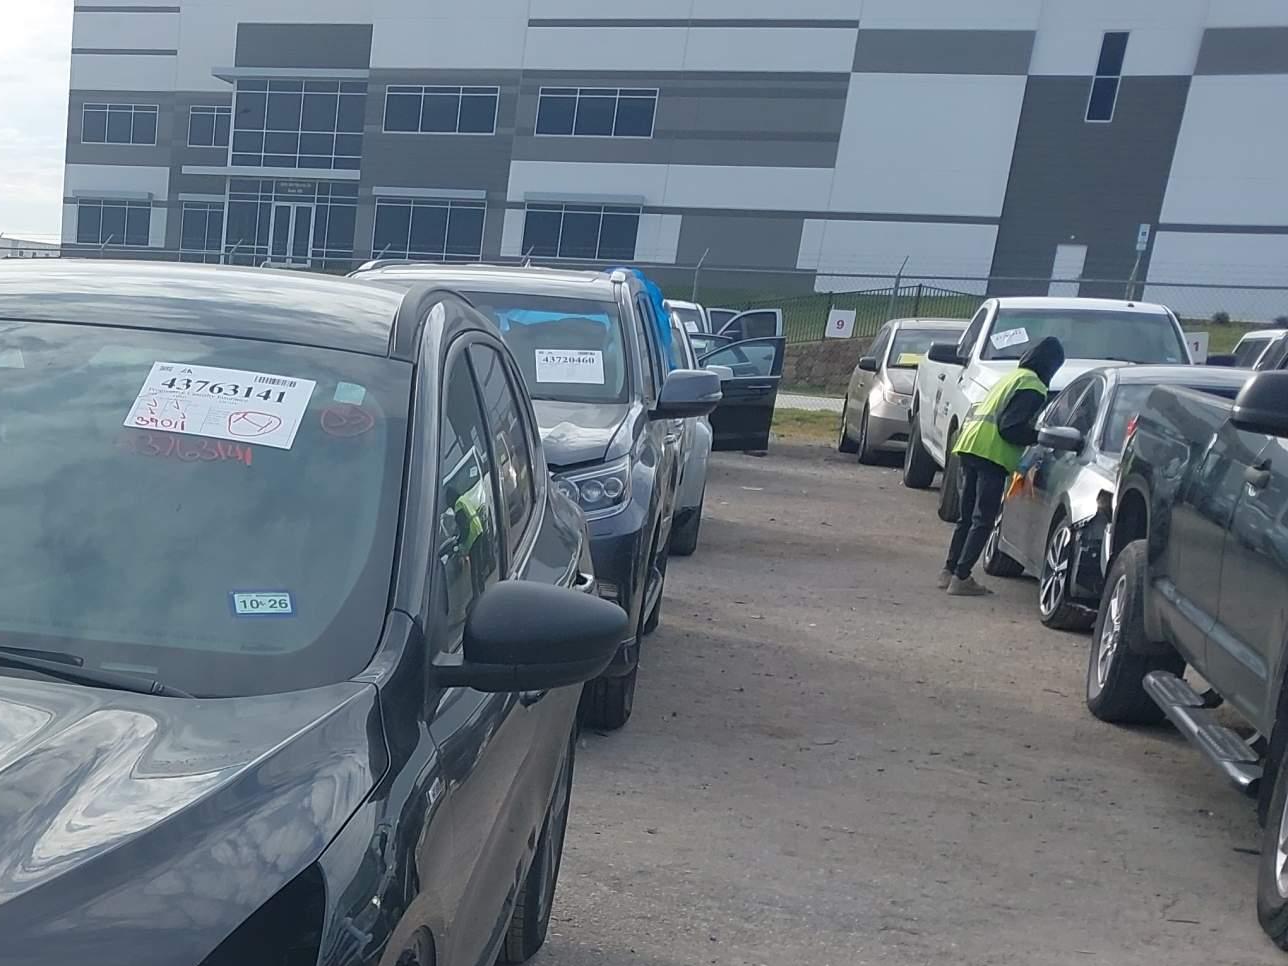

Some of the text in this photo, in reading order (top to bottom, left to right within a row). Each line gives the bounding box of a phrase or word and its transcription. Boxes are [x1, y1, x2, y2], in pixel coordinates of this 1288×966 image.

[836, 319, 845, 330] 9
[161, 377, 286, 404] 43763141
[239, 598, 289, 609] 10 26
